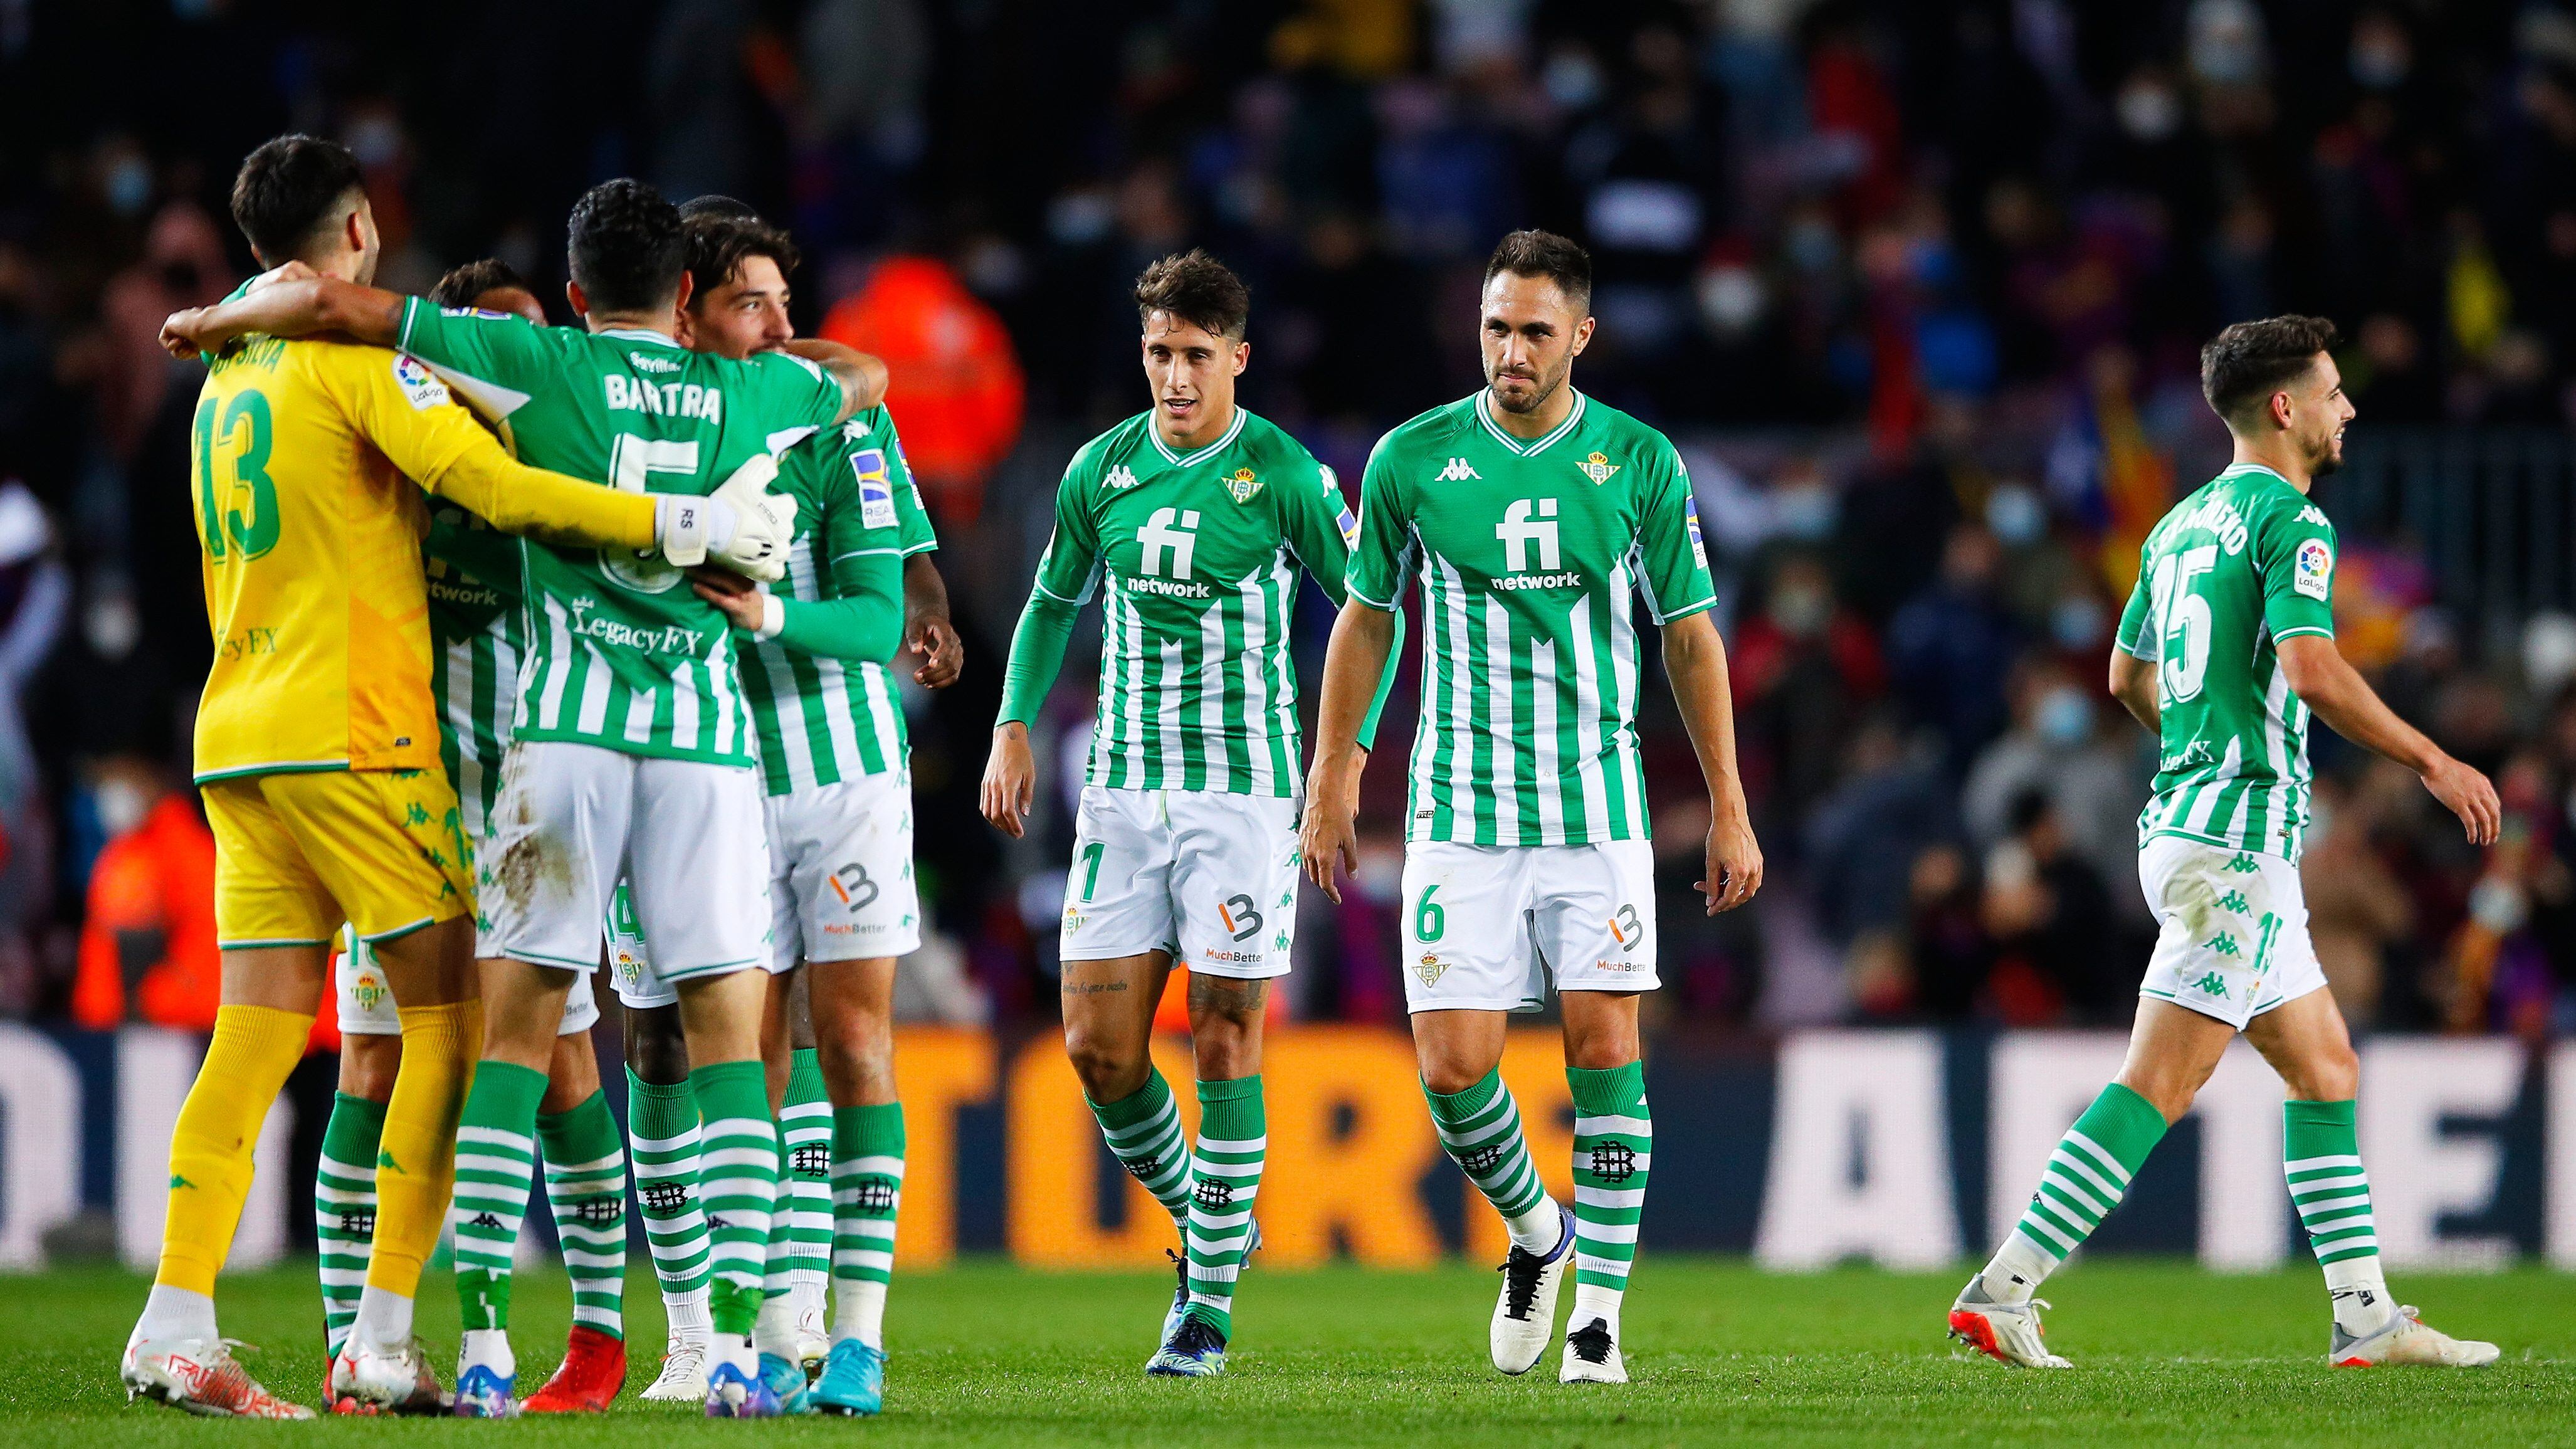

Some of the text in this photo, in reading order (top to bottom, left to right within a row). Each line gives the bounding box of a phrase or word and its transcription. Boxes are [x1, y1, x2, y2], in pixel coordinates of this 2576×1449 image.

[603, 374, 722, 425] BARTRA
[192, 387, 281, 565] 13
[680, 508, 694, 529] RS
[1136, 507, 1201, 580] fi
[1495, 498, 1561, 572] fi
[430, 581, 498, 606] twork
[1127, 577, 1211, 599] network
[1490, 570, 1582, 591] network
[2299, 577, 2325, 593] LaLiga
[572, 606, 704, 656] LegacyFX
[2151, 544, 2219, 710] 15
[1413, 884, 1446, 945] 6
[1206, 947, 1263, 963] MuchBetter
